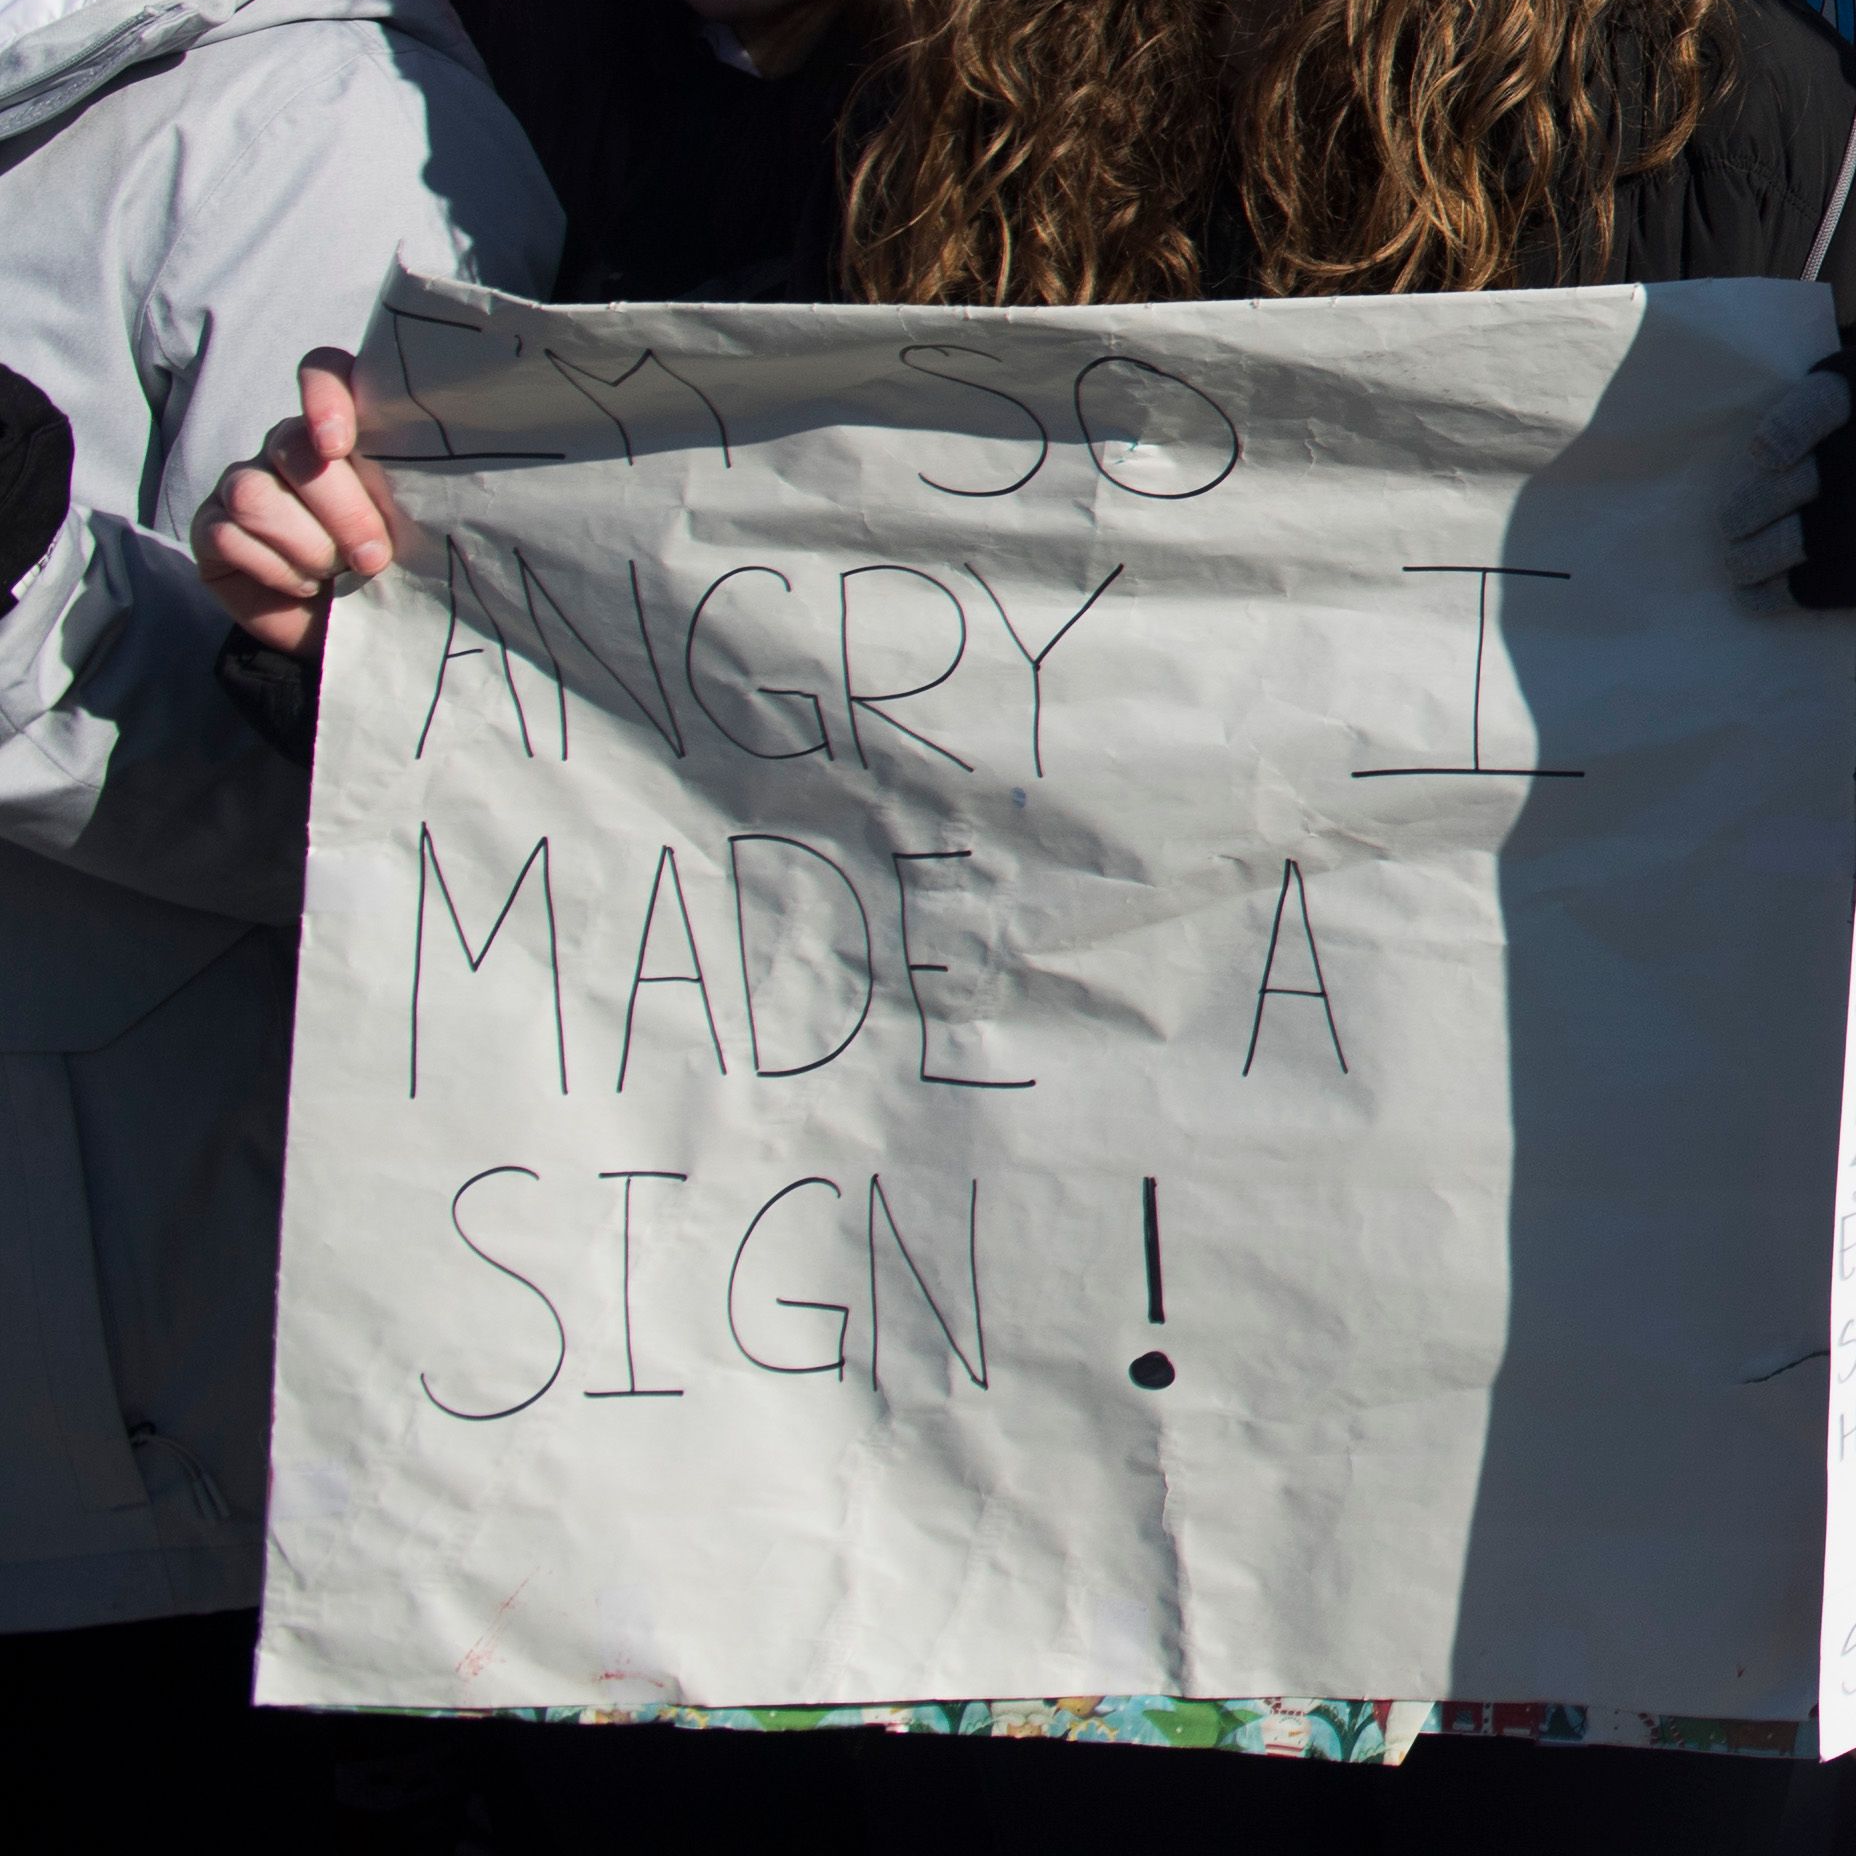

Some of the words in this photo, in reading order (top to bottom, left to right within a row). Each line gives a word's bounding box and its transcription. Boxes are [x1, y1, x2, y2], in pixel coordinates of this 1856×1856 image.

[377, 303, 731, 470] I'M
[897, 340, 1239, 499] SO
[415, 534, 1123, 778] ANGRY
[1352, 563, 1584, 778] I
[410, 821, 1037, 1101] MADE
[1243, 858, 1346, 1077] A
